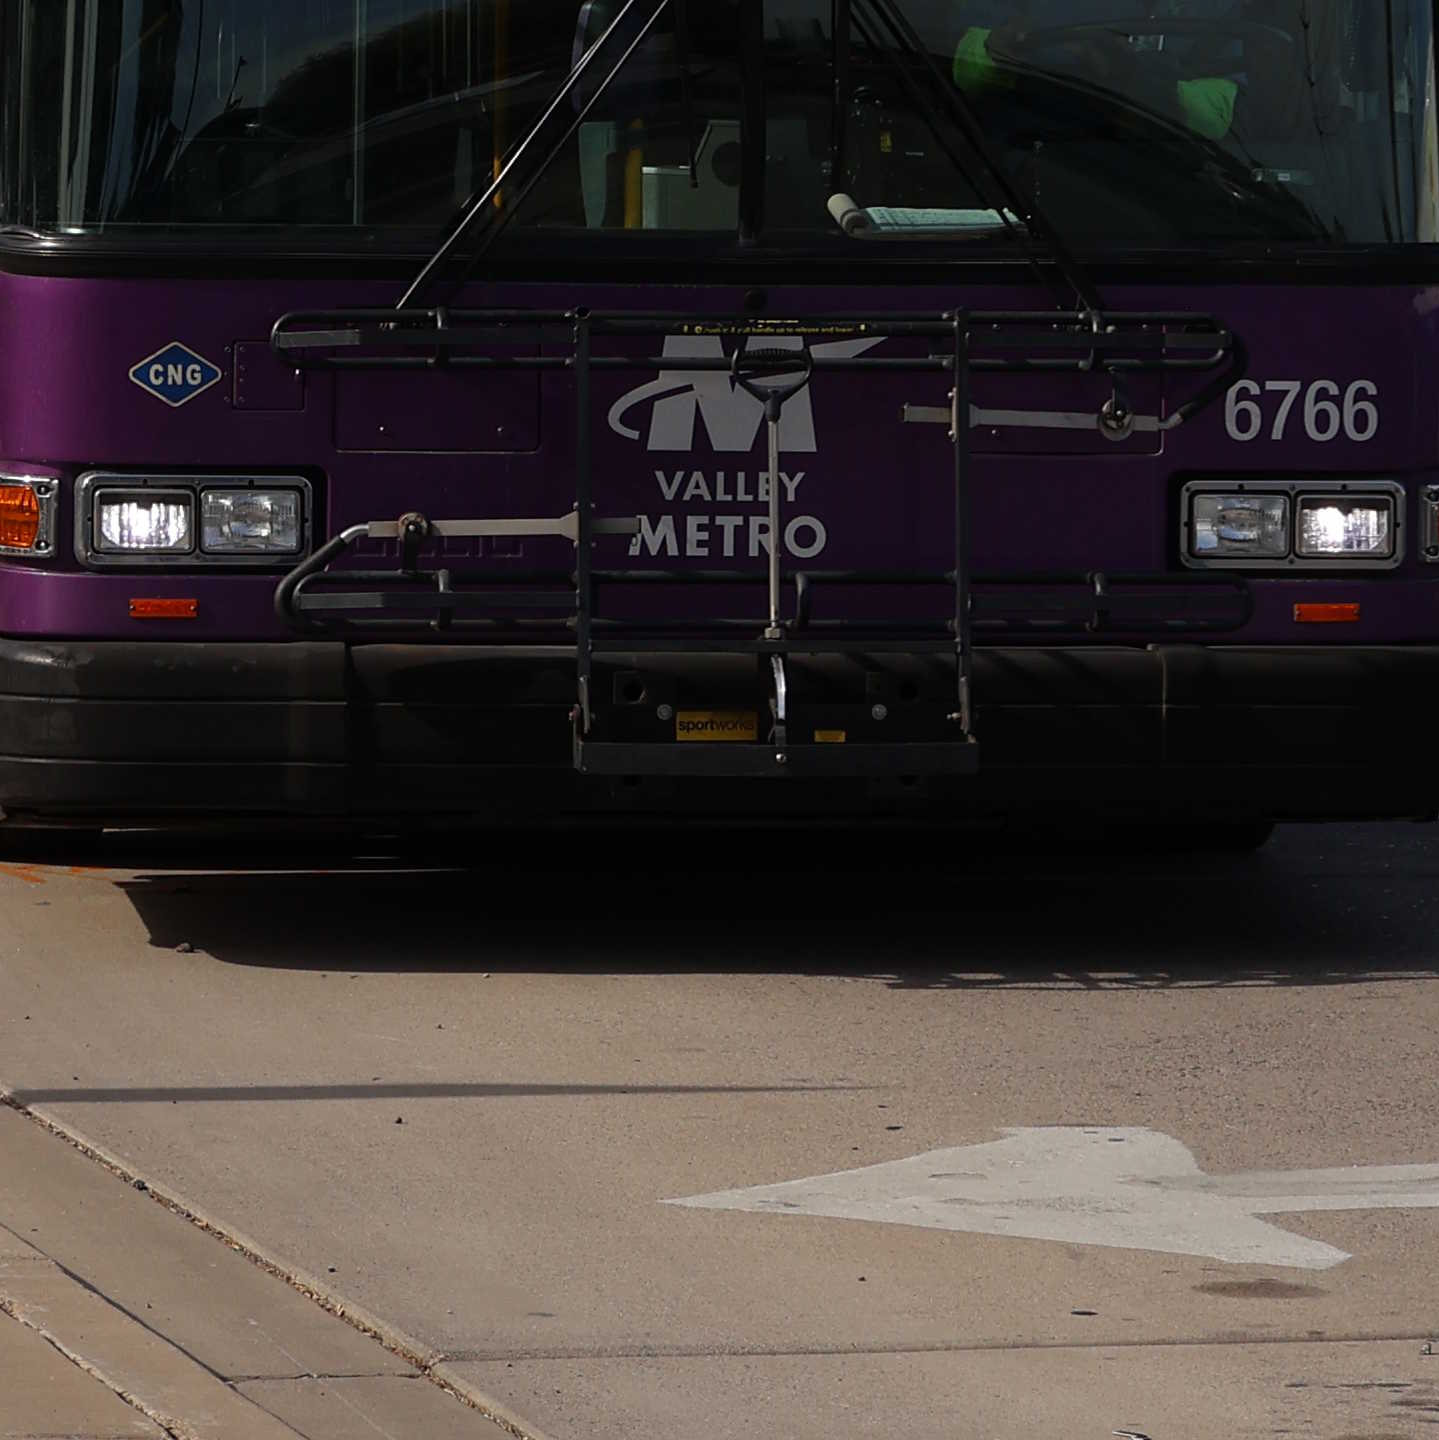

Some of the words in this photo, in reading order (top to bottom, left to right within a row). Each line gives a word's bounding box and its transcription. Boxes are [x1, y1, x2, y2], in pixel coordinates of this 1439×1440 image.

[149, 363, 202, 386] CNG
[1225, 379, 1378, 441] 6766
[654, 470, 806, 502] VALLEY
[628, 514, 827, 558] METRO
